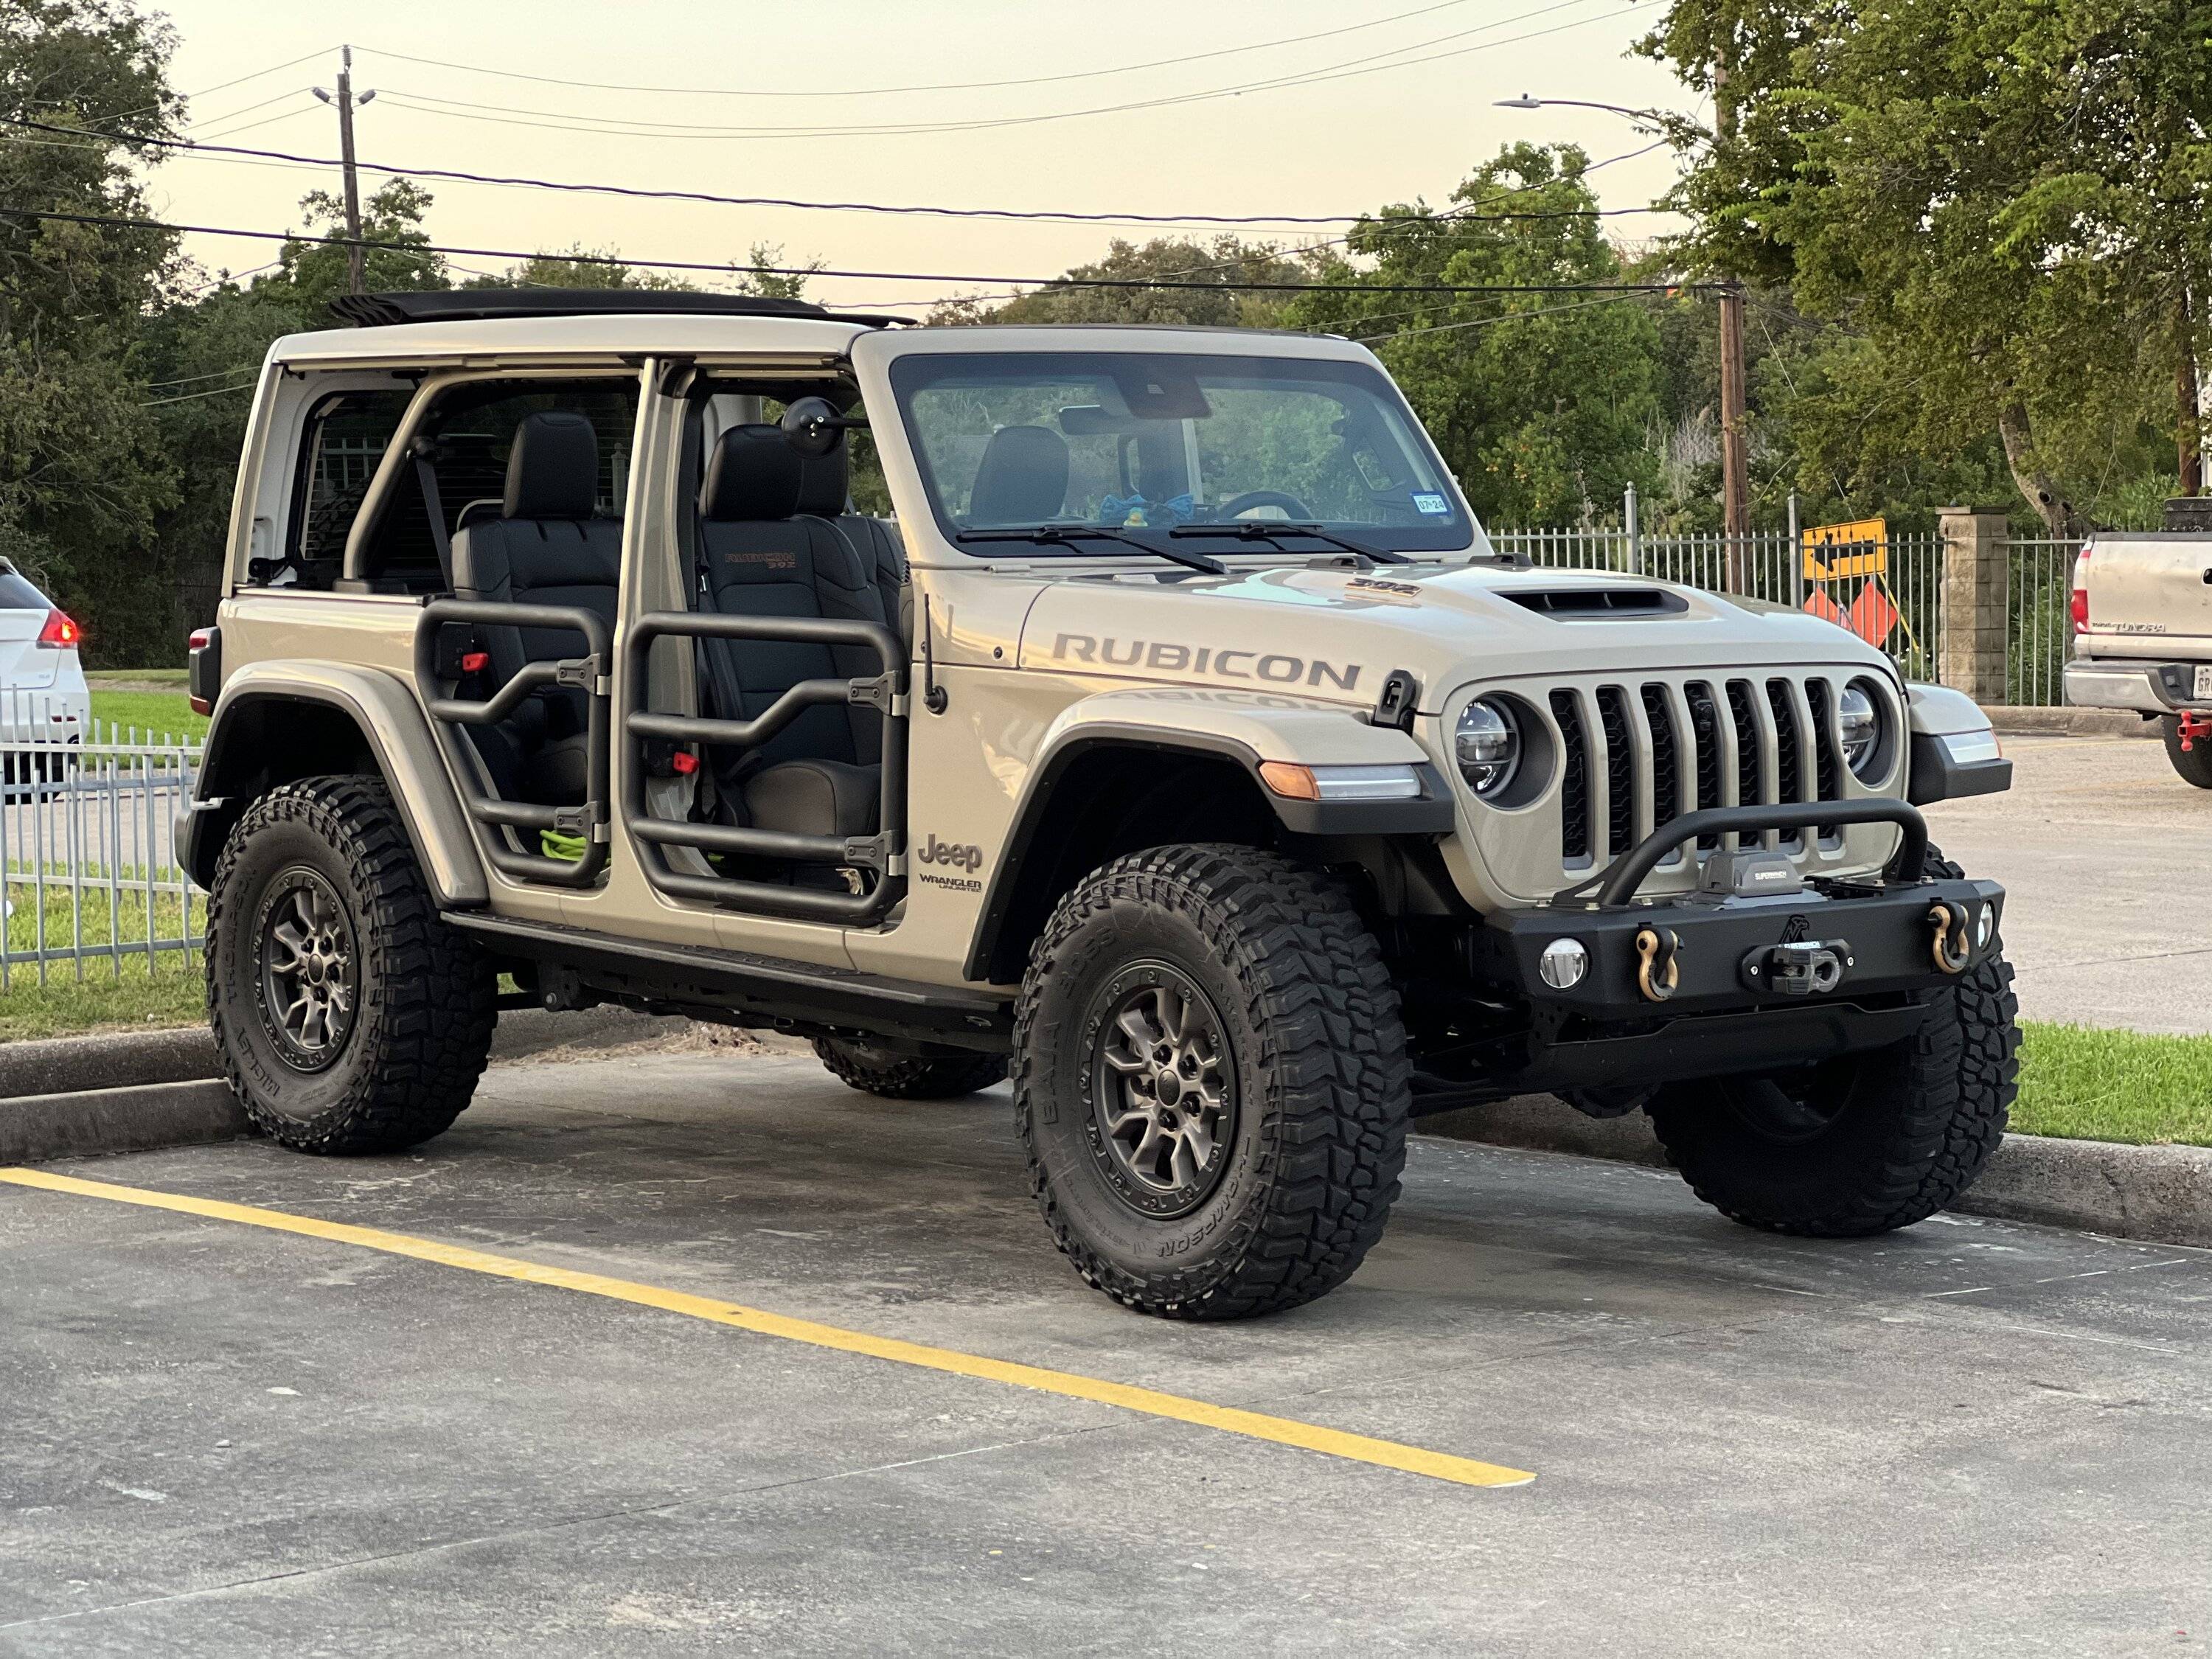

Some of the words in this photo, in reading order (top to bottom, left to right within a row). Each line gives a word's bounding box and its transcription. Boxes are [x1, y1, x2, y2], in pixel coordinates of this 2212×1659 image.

[2112, 622, 2166, 633] TUNDRA
[1052, 633, 1362, 690] RUBICON
[2198, 677, 2212, 692] GR
[917, 832, 982, 874] Jeep
[919, 873, 981, 888] WRANGLER
[939, 884, 981, 893] UNLIMITED
